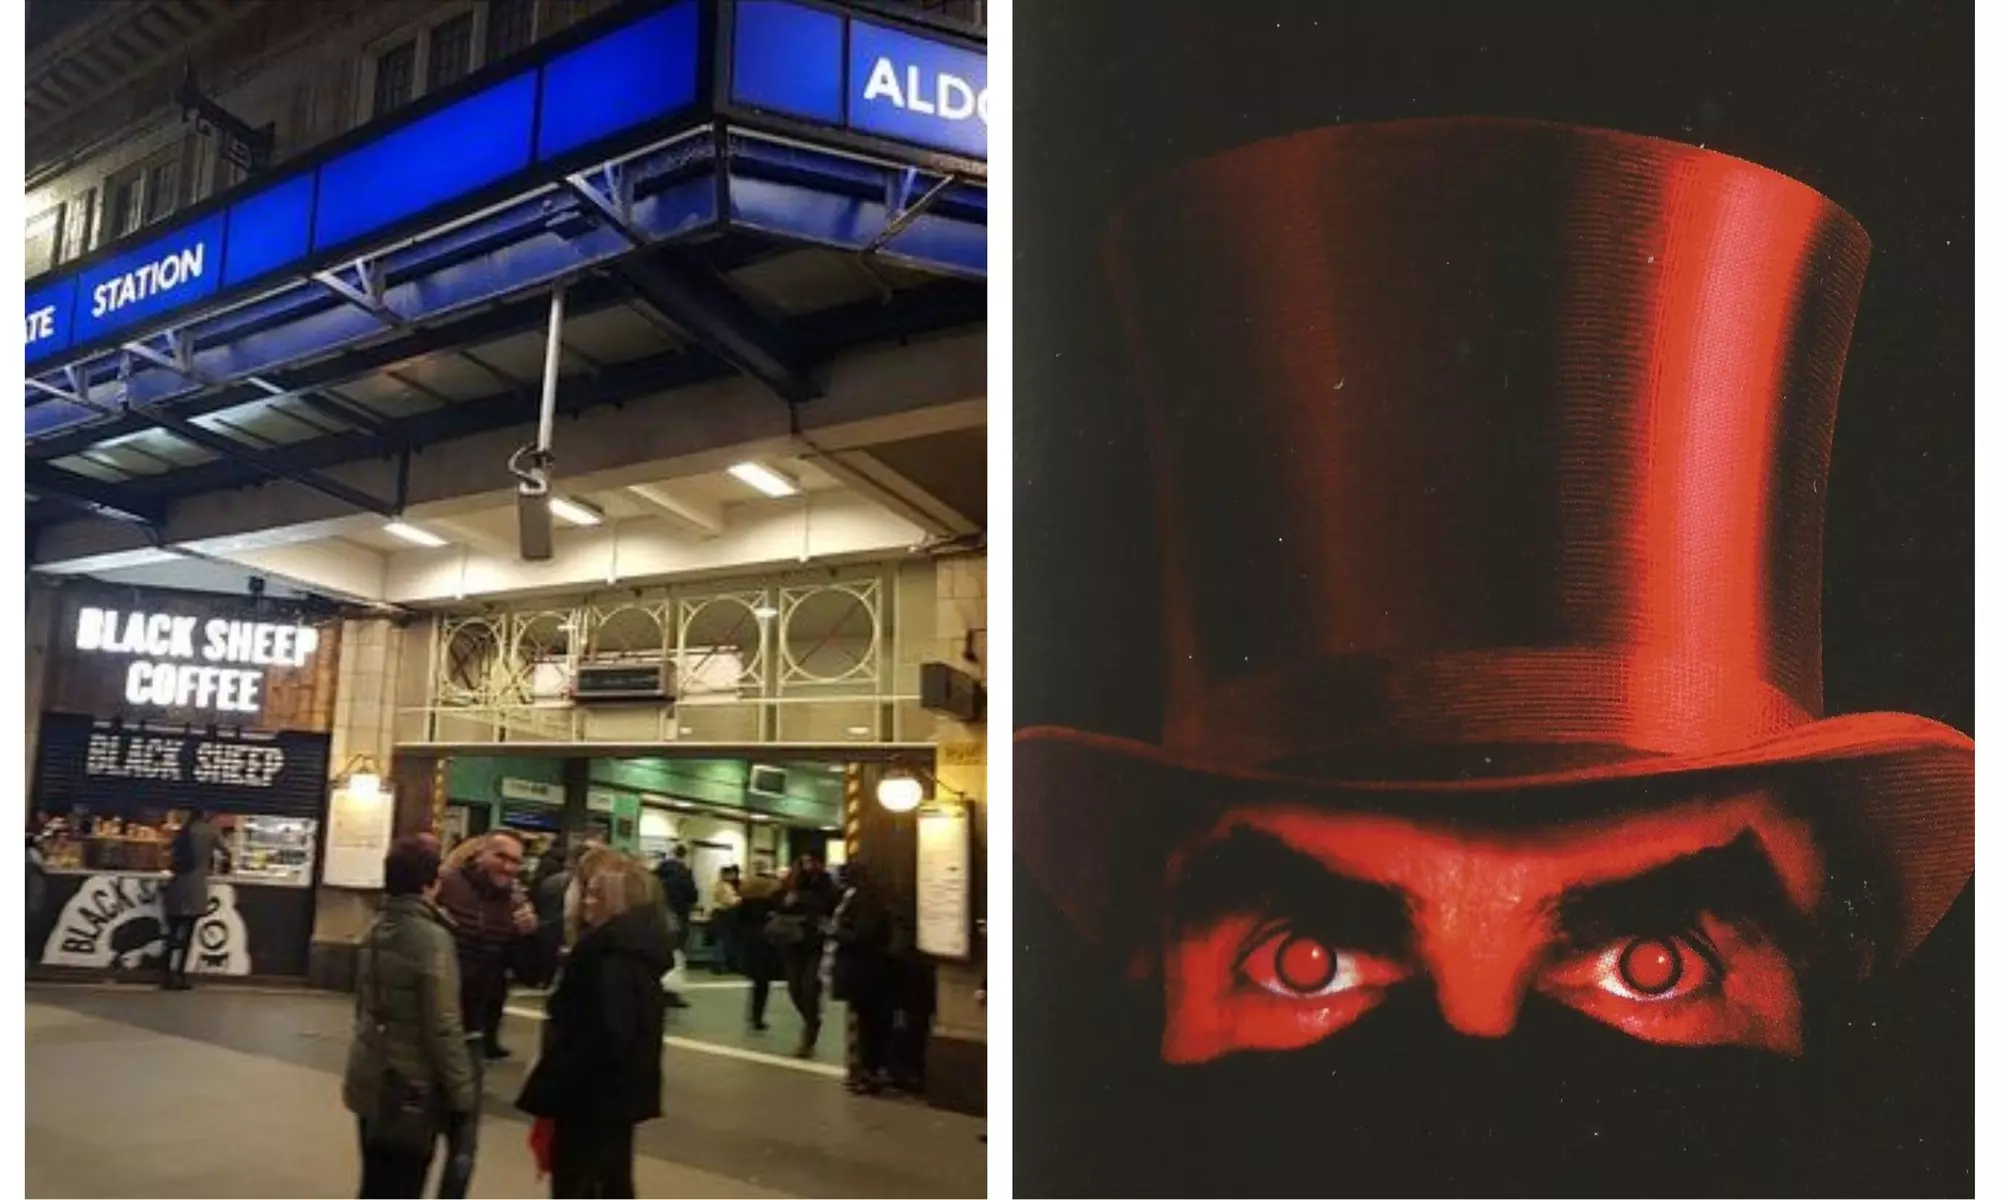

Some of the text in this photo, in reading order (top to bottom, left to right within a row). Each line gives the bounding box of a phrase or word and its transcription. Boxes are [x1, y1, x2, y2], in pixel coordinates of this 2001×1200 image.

[863, 57, 987, 124] ALD
[25, 243, 204, 343] TE STATION
[77, 607, 319, 667] BLACK SHEEP
[125, 660, 263, 711] COFFEE
[86, 733, 285, 787] BLACK SHEEP
[62, 875, 136, 953] BLACK
